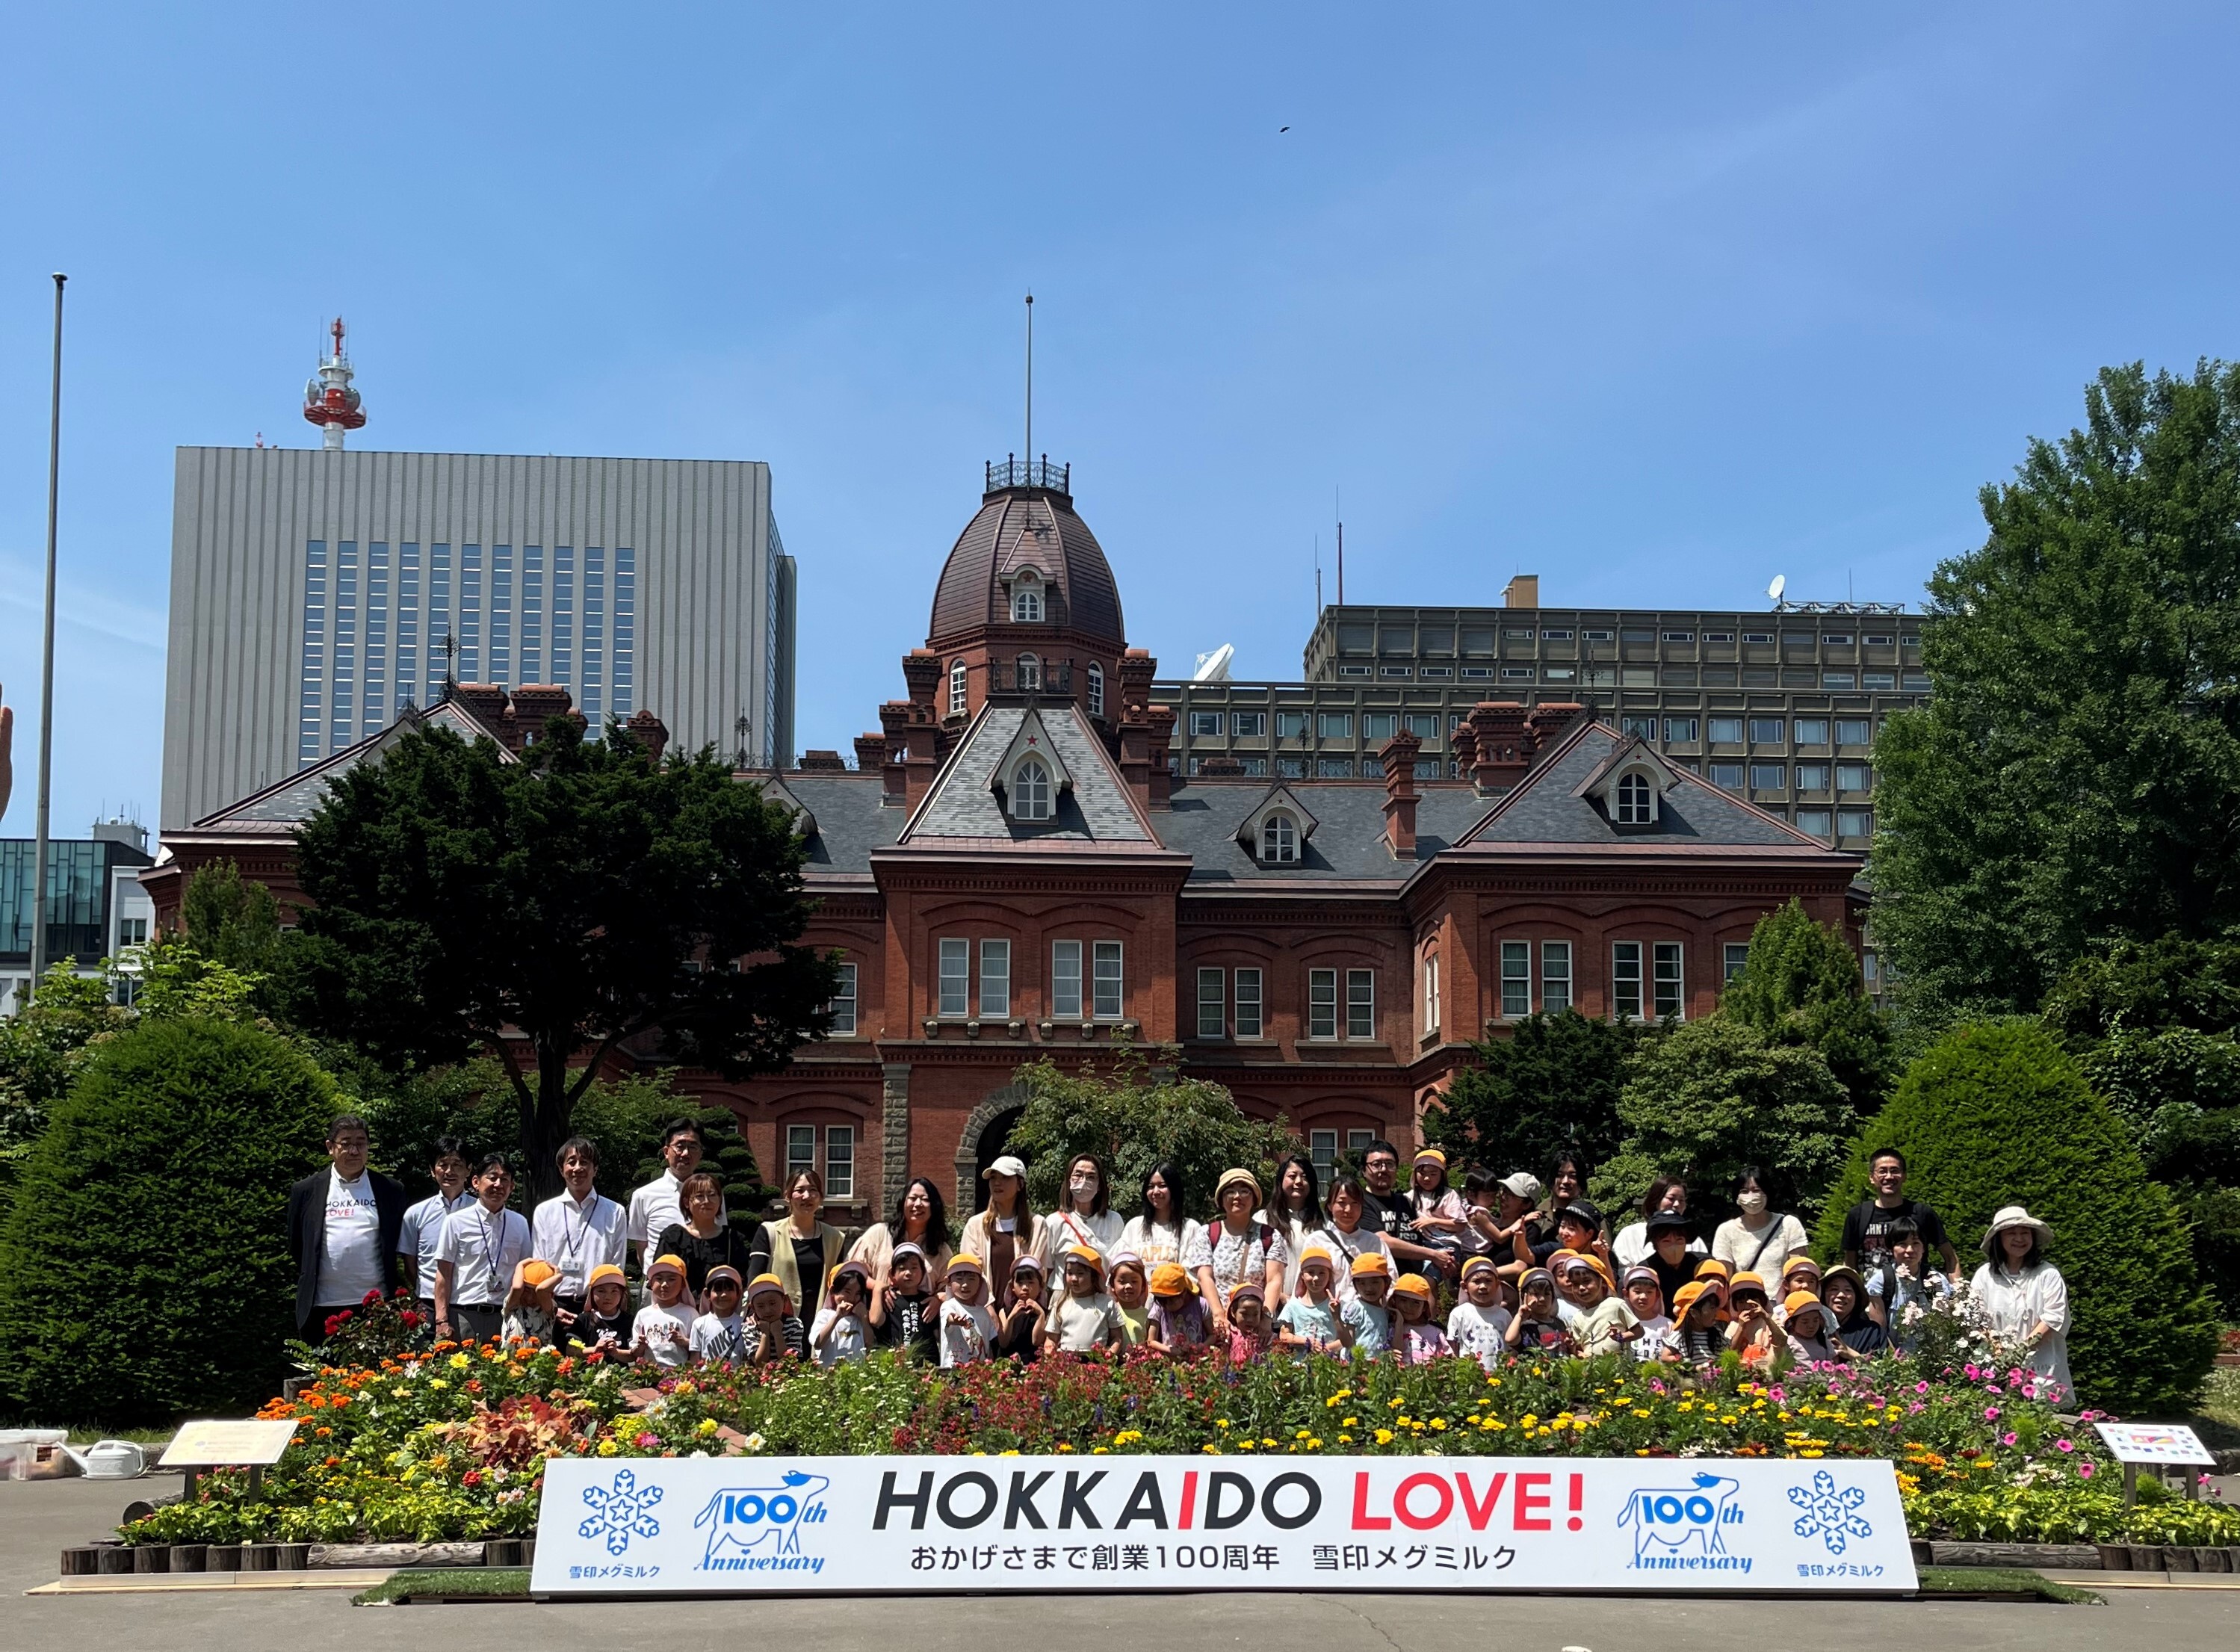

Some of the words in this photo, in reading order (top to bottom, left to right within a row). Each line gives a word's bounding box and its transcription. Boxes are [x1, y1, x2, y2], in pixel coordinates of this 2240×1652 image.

[707, 1325, 734, 1361] NIKE
[872, 1470, 1322, 1530] HOKKAIDO
[1352, 1472, 1582, 1531] LOVE!
[693, 1553, 825, 1574] Anniversary
[911, 1544, 1280, 1571] おかげさまで創業100周年
[1313, 1544, 1515, 1571] 雪印メグミルク
[1627, 1552, 1753, 1574] Anniversary
[569, 1563, 660, 1579] 雪印メグミルク
[1797, 1562, 1884, 1577] 雪印メグミルク
